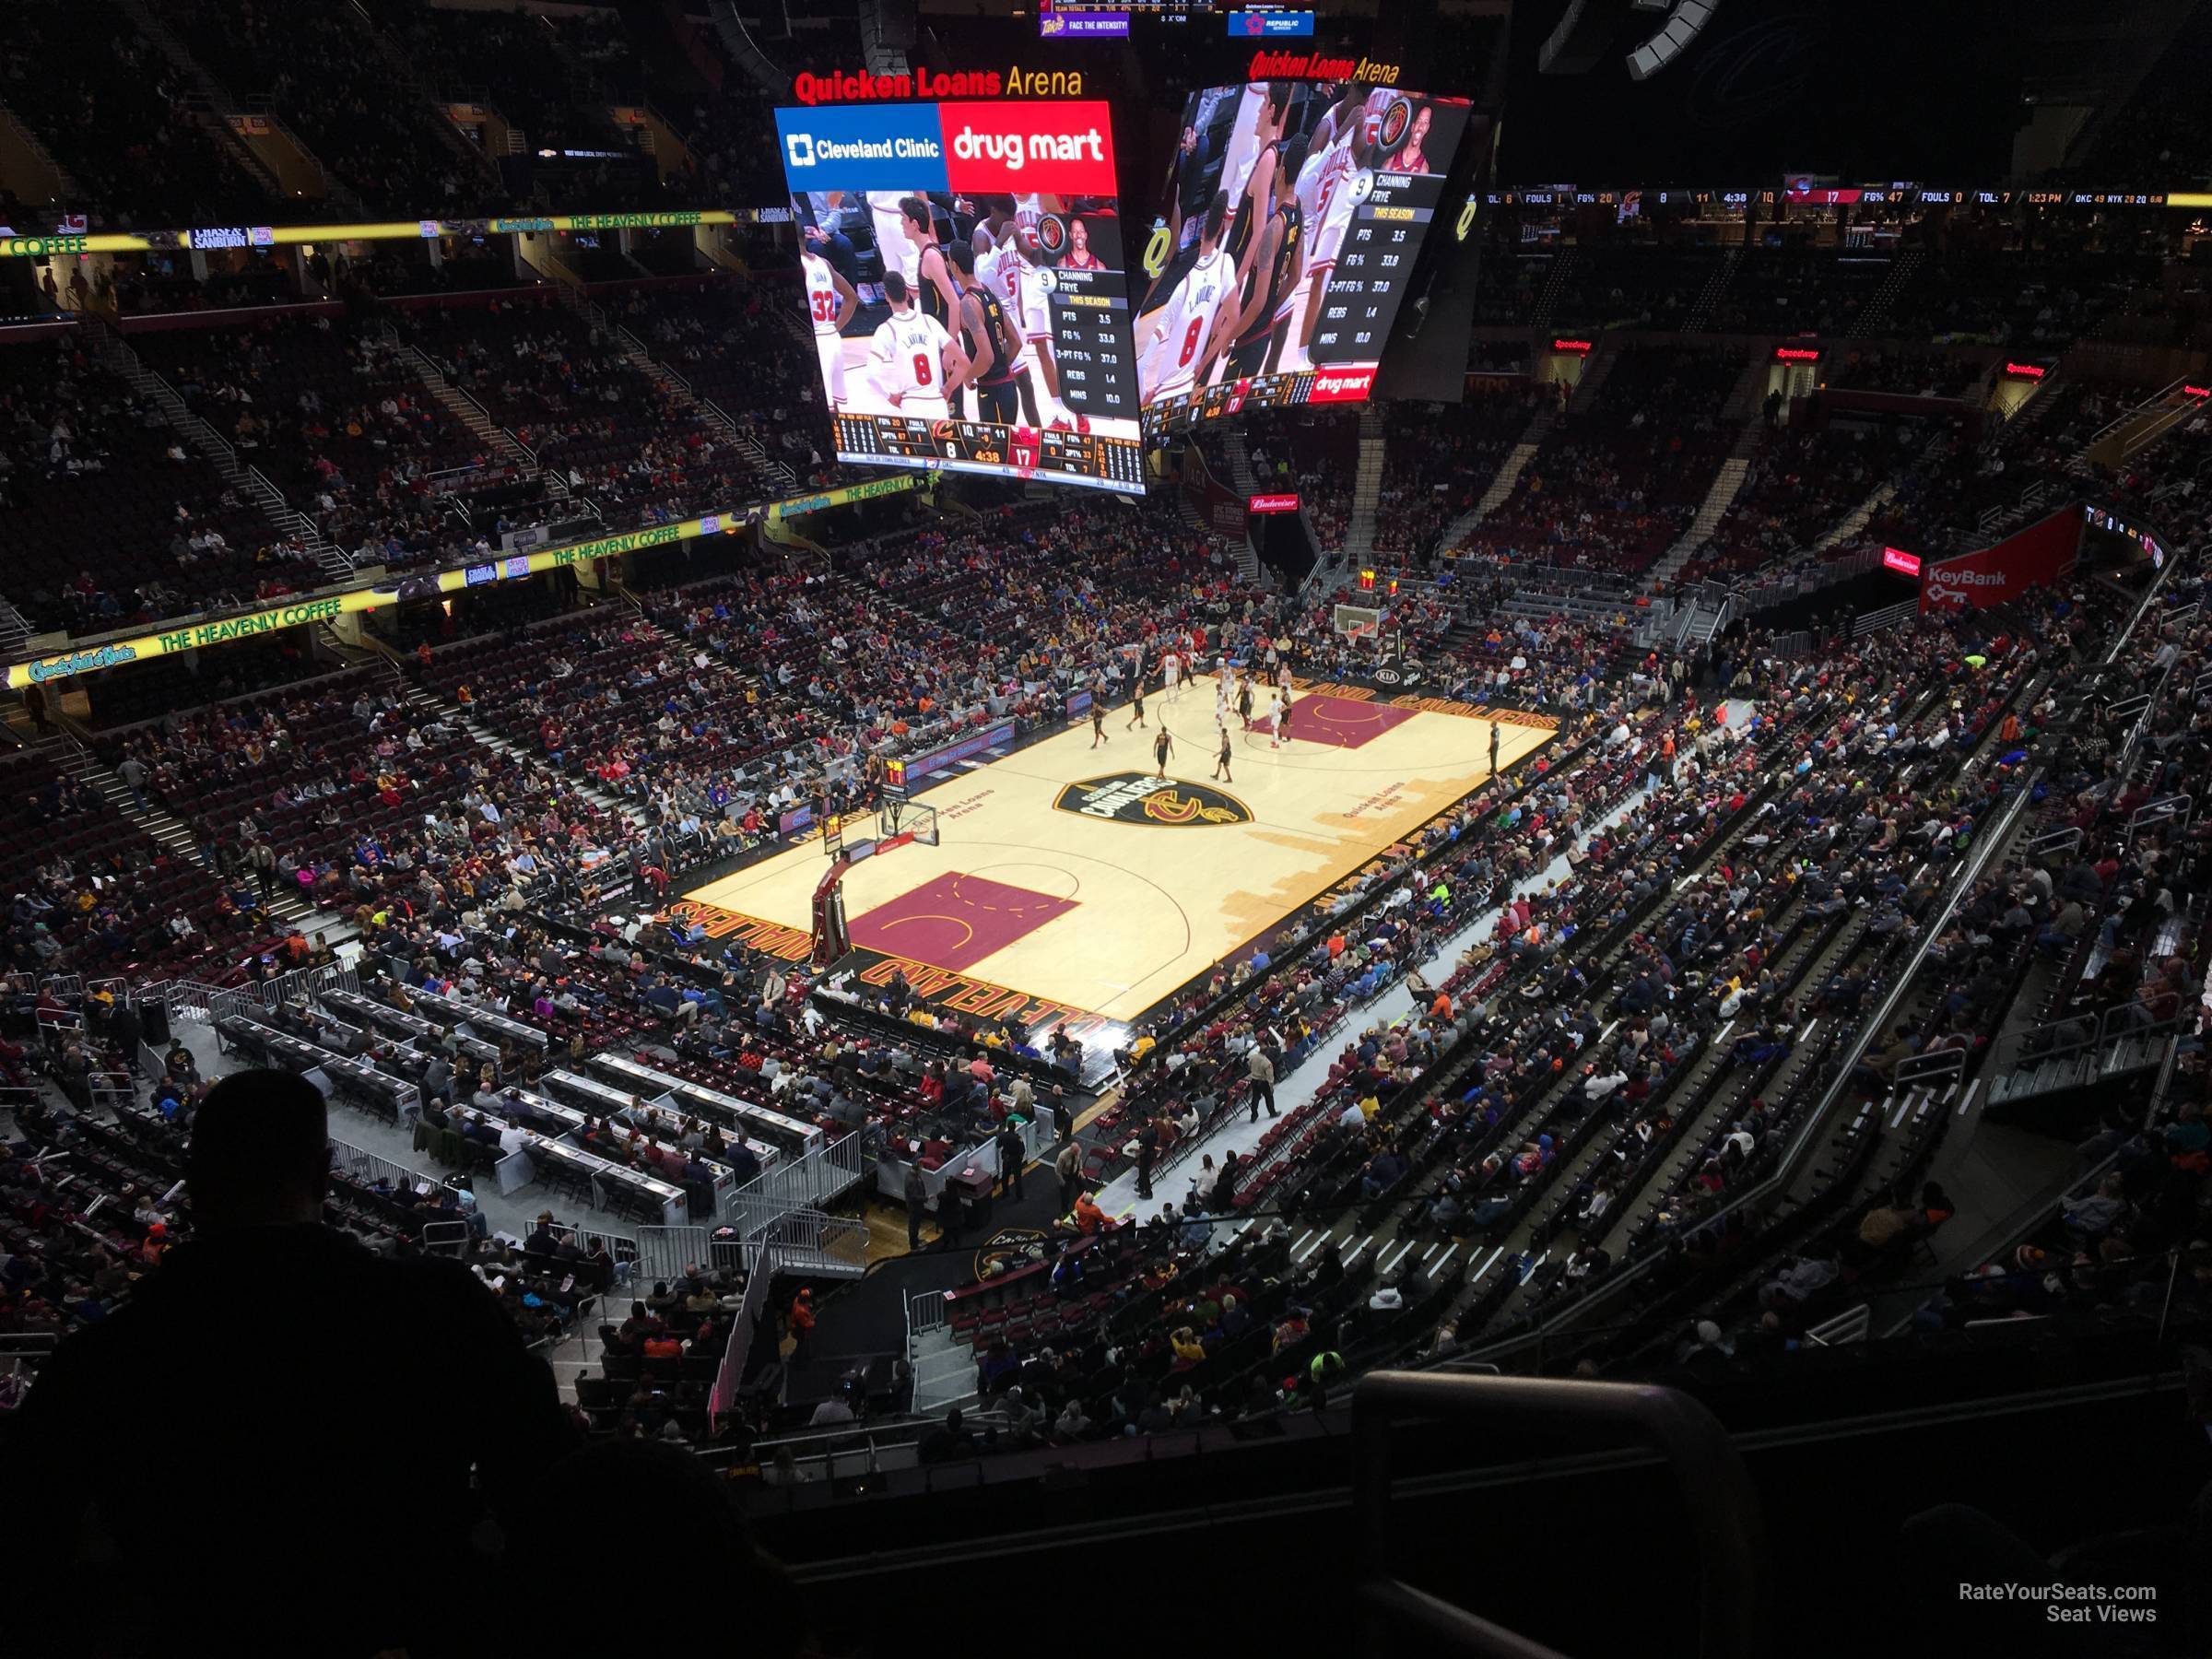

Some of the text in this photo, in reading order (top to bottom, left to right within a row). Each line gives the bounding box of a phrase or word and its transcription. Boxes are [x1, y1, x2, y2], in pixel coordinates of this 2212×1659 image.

[1069, 21, 1128, 30] FACE THE INTENSITY!
[1248, 51, 1400, 85] Quicken Loans Arena
[795, 65, 1083, 104] Quicken Loans Arena
[817, 137, 939, 160] Cleveland Clinic
[954, 126, 1104, 170] drug mart
[1376, 174, 1412, 189] CHANNING
[1357, 178, 1391, 203] 9 FRYE
[1828, 191, 1839, 203] 17
[1864, 192, 1903, 203] FG% 47
[1922, 192, 1950, 203] FOULS
[1979, 192, 2010, 203] TOL: 7
[1506, 194, 1512, 205] 6
[1525, 194, 1552, 204] FOULS
[1577, 194, 1612, 204] FG% 20
[1660, 193, 1666, 204] 8
[1696, 193, 1708, 203] 11
[1724, 193, 1747, 203] 4:38
[2029, 193, 2062, 203] 1:23 PM
[2076, 194, 2092, 204] OKC
[2107, 194, 2123, 204] NYK
[569, 211, 700, 229] THE HEAVENLY COFFEE
[1373, 207, 1415, 220] THIS SEASON
[194, 235, 246, 249] SANBORN
[1357, 229, 1406, 242] PTS 3.5
[9, 235, 88, 258] COFFEE
[1143, 227, 1171, 280] Q
[1346, 254, 1398, 266] FG % 33.8
[1041, 273, 1078, 293] 9 FRYE
[1058, 271, 1093, 282] CHANNING
[1328, 280, 1389, 294] 3-PT FG % 37.0
[1069, 295, 1111, 307] THIS SEASON
[1063, 312, 1112, 324] PTS 3.5
[1327, 306, 1377, 320] REBS 1.4
[904, 333, 928, 349] LAVINE
[1063, 330, 1115, 344] FG % 33.8
[1179, 316, 1203, 368] 8
[1319, 331, 1371, 345] MINS 10.0
[1556, 339, 1592, 350] Speedway
[1056, 349, 1117, 364] 3-PT FG % 37.0
[1778, 348, 1819, 360] Speedway
[912, 353, 933, 386] 8
[2006, 363, 2045, 377] Speedway
[1066, 370, 1116, 384] REBS 1.4
[1316, 374, 1342, 393] drug
[1342, 374, 1370, 390] mart
[1070, 389, 1121, 404] MINS 10.0
[892, 418, 900, 427] 20
[995, 429, 1006, 439] 11
[1067, 435, 1079, 443] FG%
[946, 441, 957, 458] 8
[975, 450, 1000, 463] 4:38
[1050, 446, 1056, 456] 0
[1065, 449, 1091, 459] 3PT% 33
[1017, 449, 1030, 465] 17
[1065, 463, 1088, 474] TOL 7
[846, 478, 905, 501] THE HEAVENLY
[1252, 499, 1296, 510] Budweiser
[553, 525, 680, 566] THE HEAVENLY COFFEE
[508, 559, 526, 570] drug
[510, 564, 529, 575] mart
[1929, 567, 2006, 586] KeyBank
[158, 598, 342, 653] THE HEAVENLY COFFEE
[1378, 673, 1395, 681] KIA
[1080, 776, 1179, 818] CAVALIERS
[1379, 782, 1406, 801] Loans
[959, 789, 995, 810] Loans
[950, 803, 984, 820] Arena
